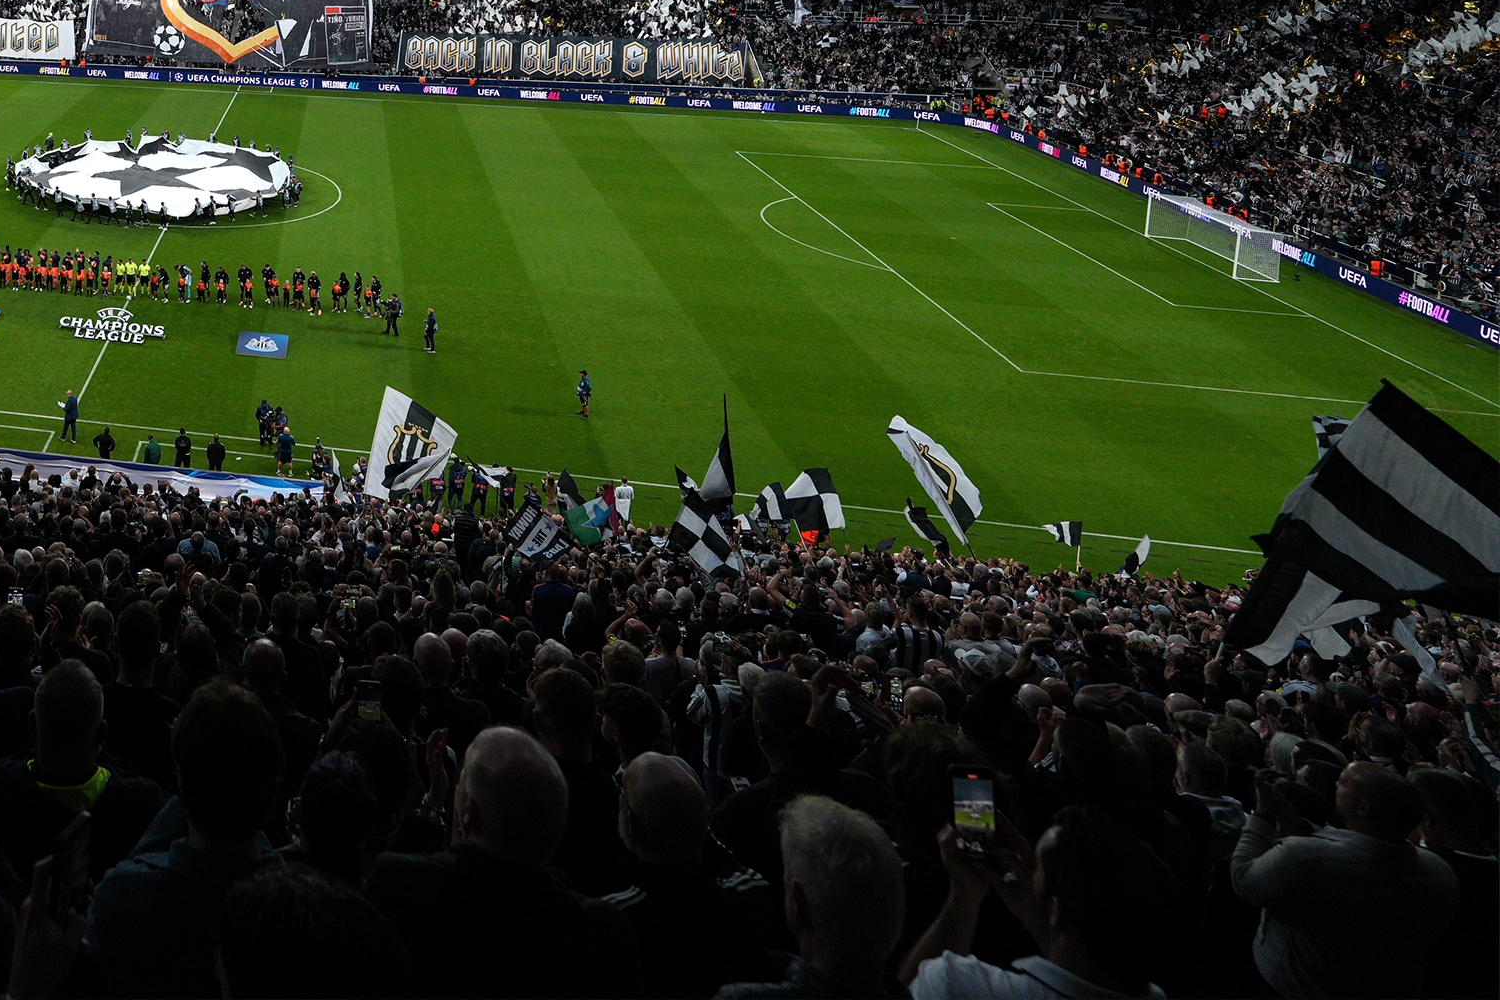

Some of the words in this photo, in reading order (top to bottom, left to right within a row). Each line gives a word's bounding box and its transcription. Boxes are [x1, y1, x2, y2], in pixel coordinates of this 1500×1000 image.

[405, 34, 476, 72] BACK
[483, 37, 513, 73] IN
[520, 38, 614, 78] BLACK
[623, 41, 647, 77] &
[0, 65, 19, 73] UEFA
[39, 66, 70, 76] #FOOTBALL
[87, 69, 107, 77] UEFA
[124, 70, 148, 80] WELCOME
[149, 71, 160, 80] ALL
[187, 74, 209, 83] UEFA
[210, 75, 260, 85] CHAMPIONS
[262, 77, 296, 87] LEAGUE
[321, 80, 347, 89] WELCOME
[348, 81, 360, 90] ALL
[378, 84, 400, 92] UEFA
[422, 85, 458, 95] #FOOTBALL
[477, 88, 500, 97] UEFA
[520, 89, 548, 99] WELCOME
[548, 90, 561, 100] ALL
[580, 93, 604, 102] UEFA
[629, 96, 666, 106] #FOOTBALL
[687, 99, 711, 108] UEFA
[732, 101, 762, 110] WELCOME
[762, 101, 776, 111] ALL
[797, 104, 822, 113] UEFA
[850, 106, 890, 118] #FOOTBALL
[913, 111, 940, 122] UEFA
[964, 117, 992, 130] WELCOME
[991, 123, 999, 134] ALL
[1010, 131, 1025, 144] UEFA
[1071, 155, 1087, 170] UEFA
[1100, 166, 1120, 184] WELCOME
[1119, 176, 1129, 188] ALL
[1272, 238, 1301, 261] WELCOME
[1300, 251, 1315, 268] ALL
[1339, 266, 1367, 288] UEFA
[1398, 291, 1450, 324] #FOOTBALL
[98, 309, 131, 322] UEFA
[60, 316, 165, 336] CHAMPIONS
[74, 327, 145, 344] LEAGUE
